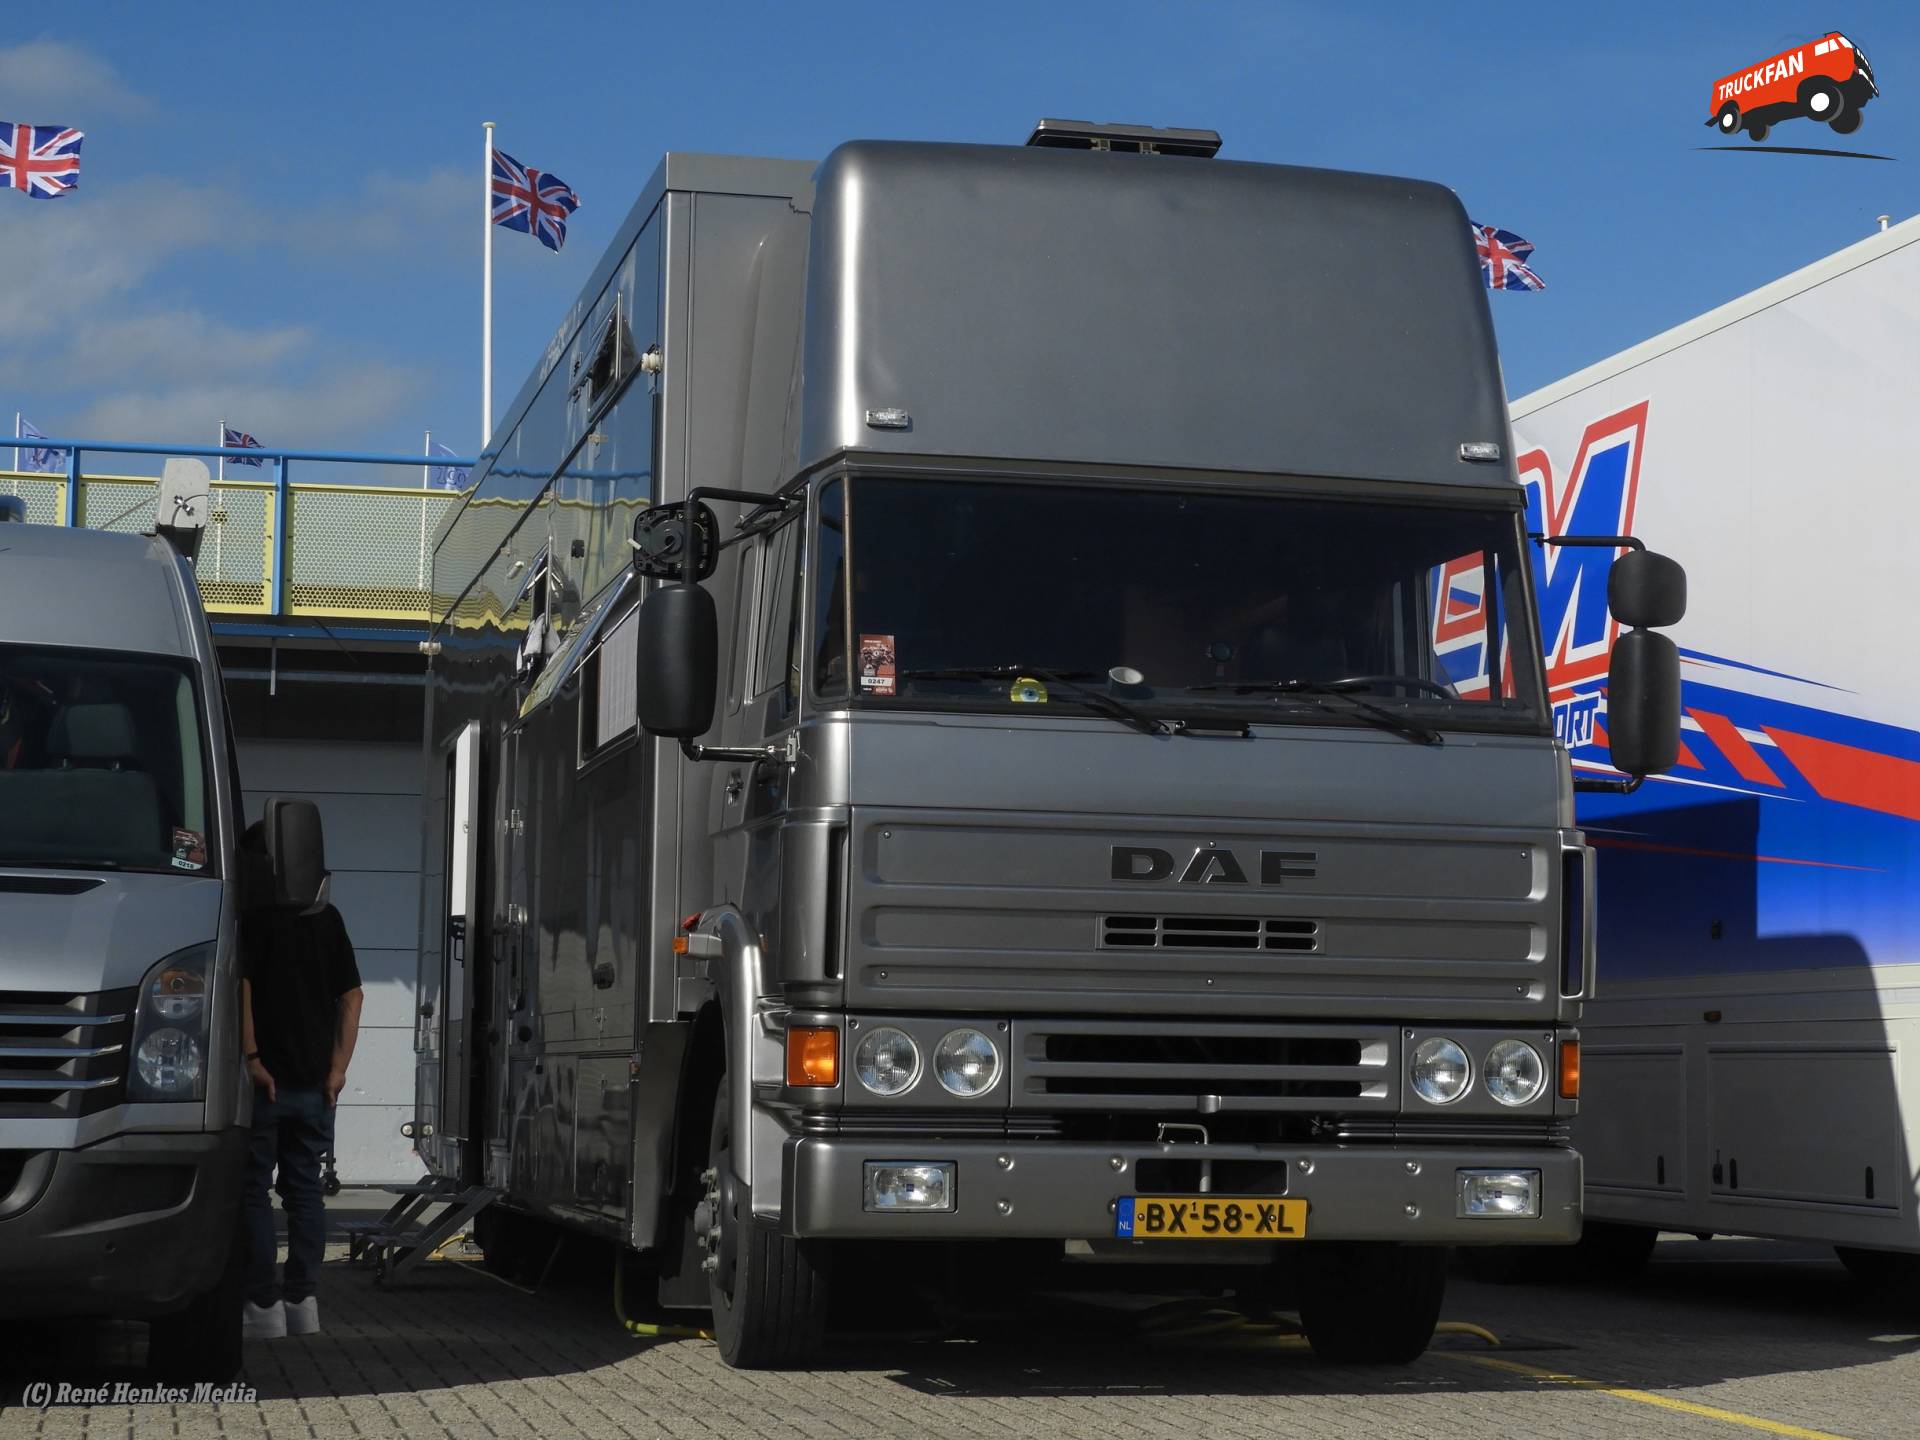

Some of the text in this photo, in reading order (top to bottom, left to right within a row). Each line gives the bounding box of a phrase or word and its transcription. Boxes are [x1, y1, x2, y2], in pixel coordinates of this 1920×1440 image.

[1551, 691, 1601, 748] ORT
[1111, 846, 1317, 885] DAF
[1119, 1203, 1294, 1234] NL BX-58-XL
